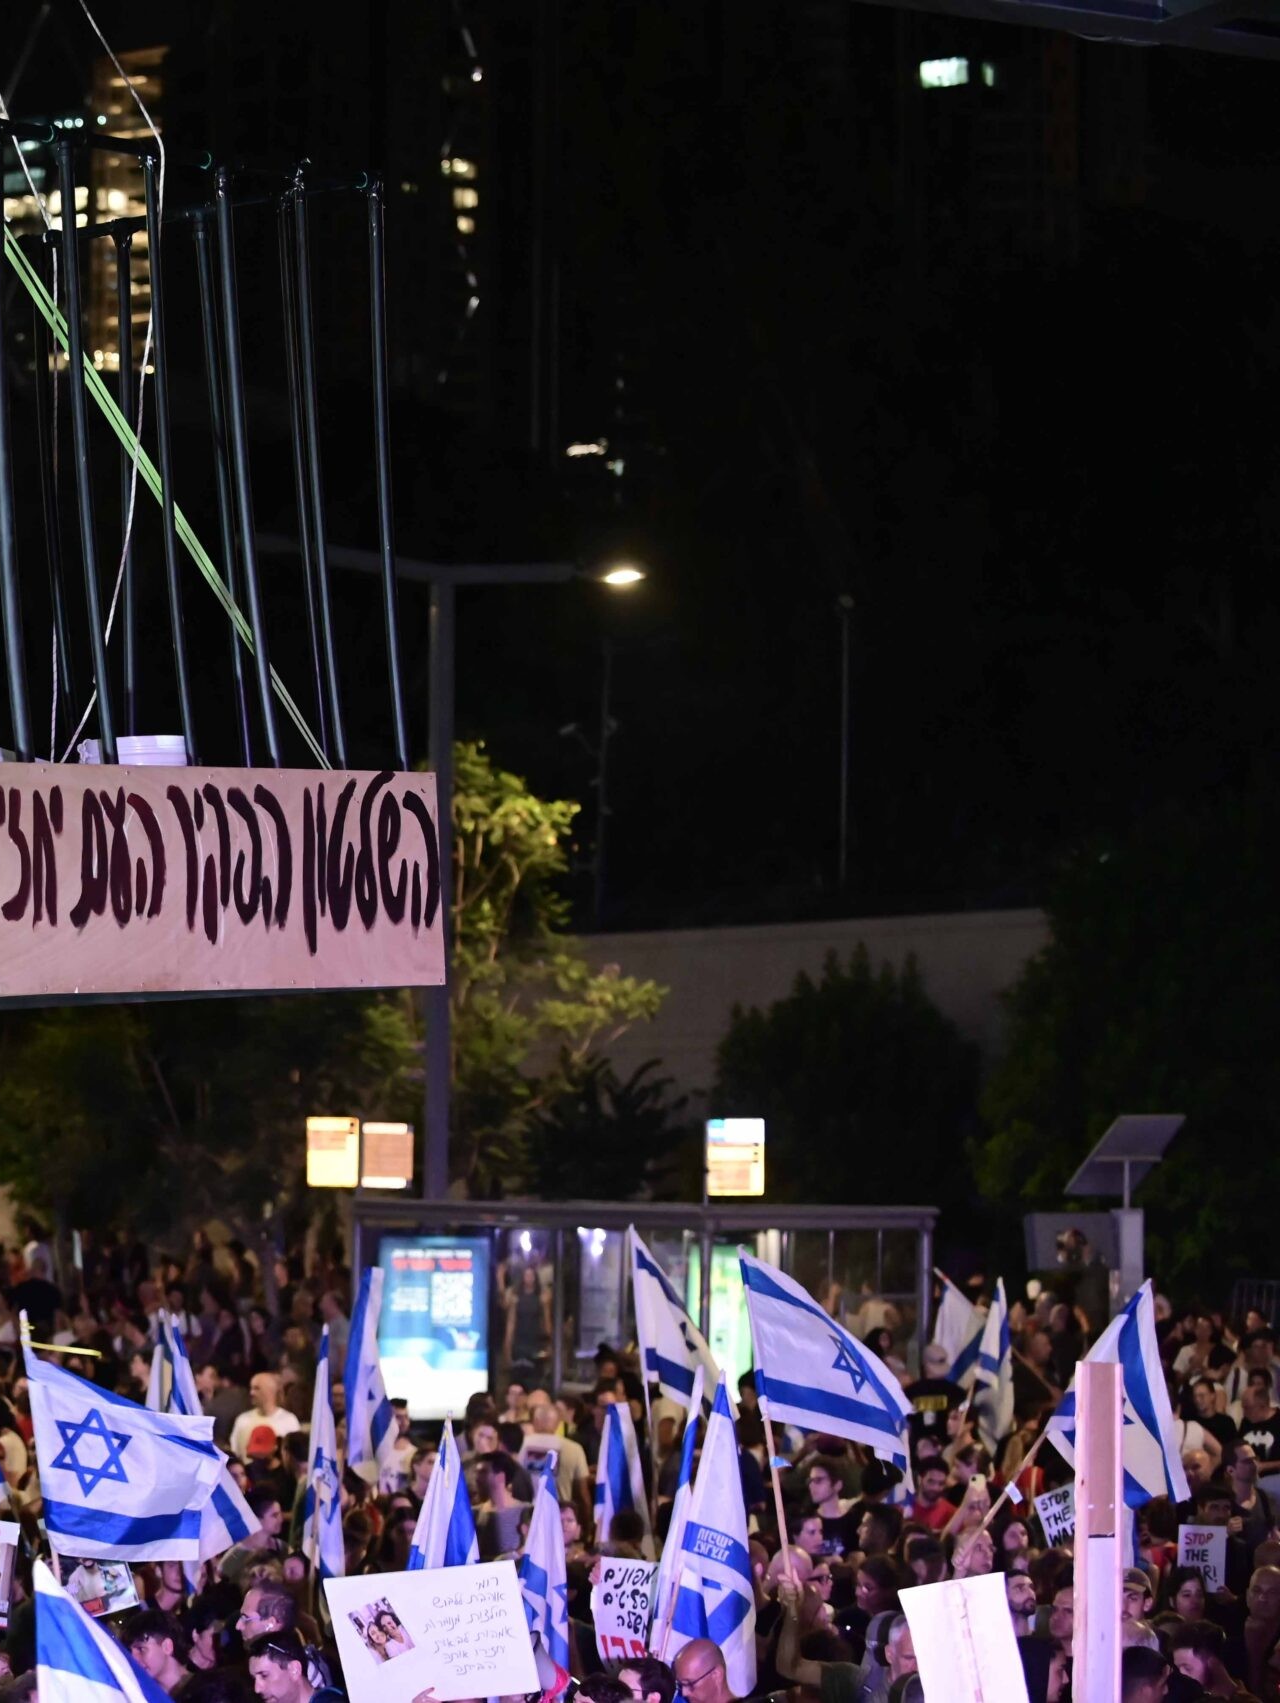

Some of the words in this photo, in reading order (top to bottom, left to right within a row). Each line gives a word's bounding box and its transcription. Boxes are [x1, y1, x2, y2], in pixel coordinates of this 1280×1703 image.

[70, 785, 166, 931] העם
[166, 783, 293, 945] הפקיר
[303, 770, 440, 956] השלטון
[1040, 1490, 1070, 1511] STOP
[1045, 1505, 1071, 1528] THE
[1184, 1532, 1214, 1546] STOP
[1185, 1549, 1209, 1562] THE
[475, 1576, 499, 1590] רומי
[603, 1566, 658, 1589] מפונים
[432, 1592, 463, 1608] ללבוש
[466, 1592, 505, 1605] אוהבת
[603, 1589, 648, 1610] פליטים
[465, 1605, 507, 1624] חולצות
